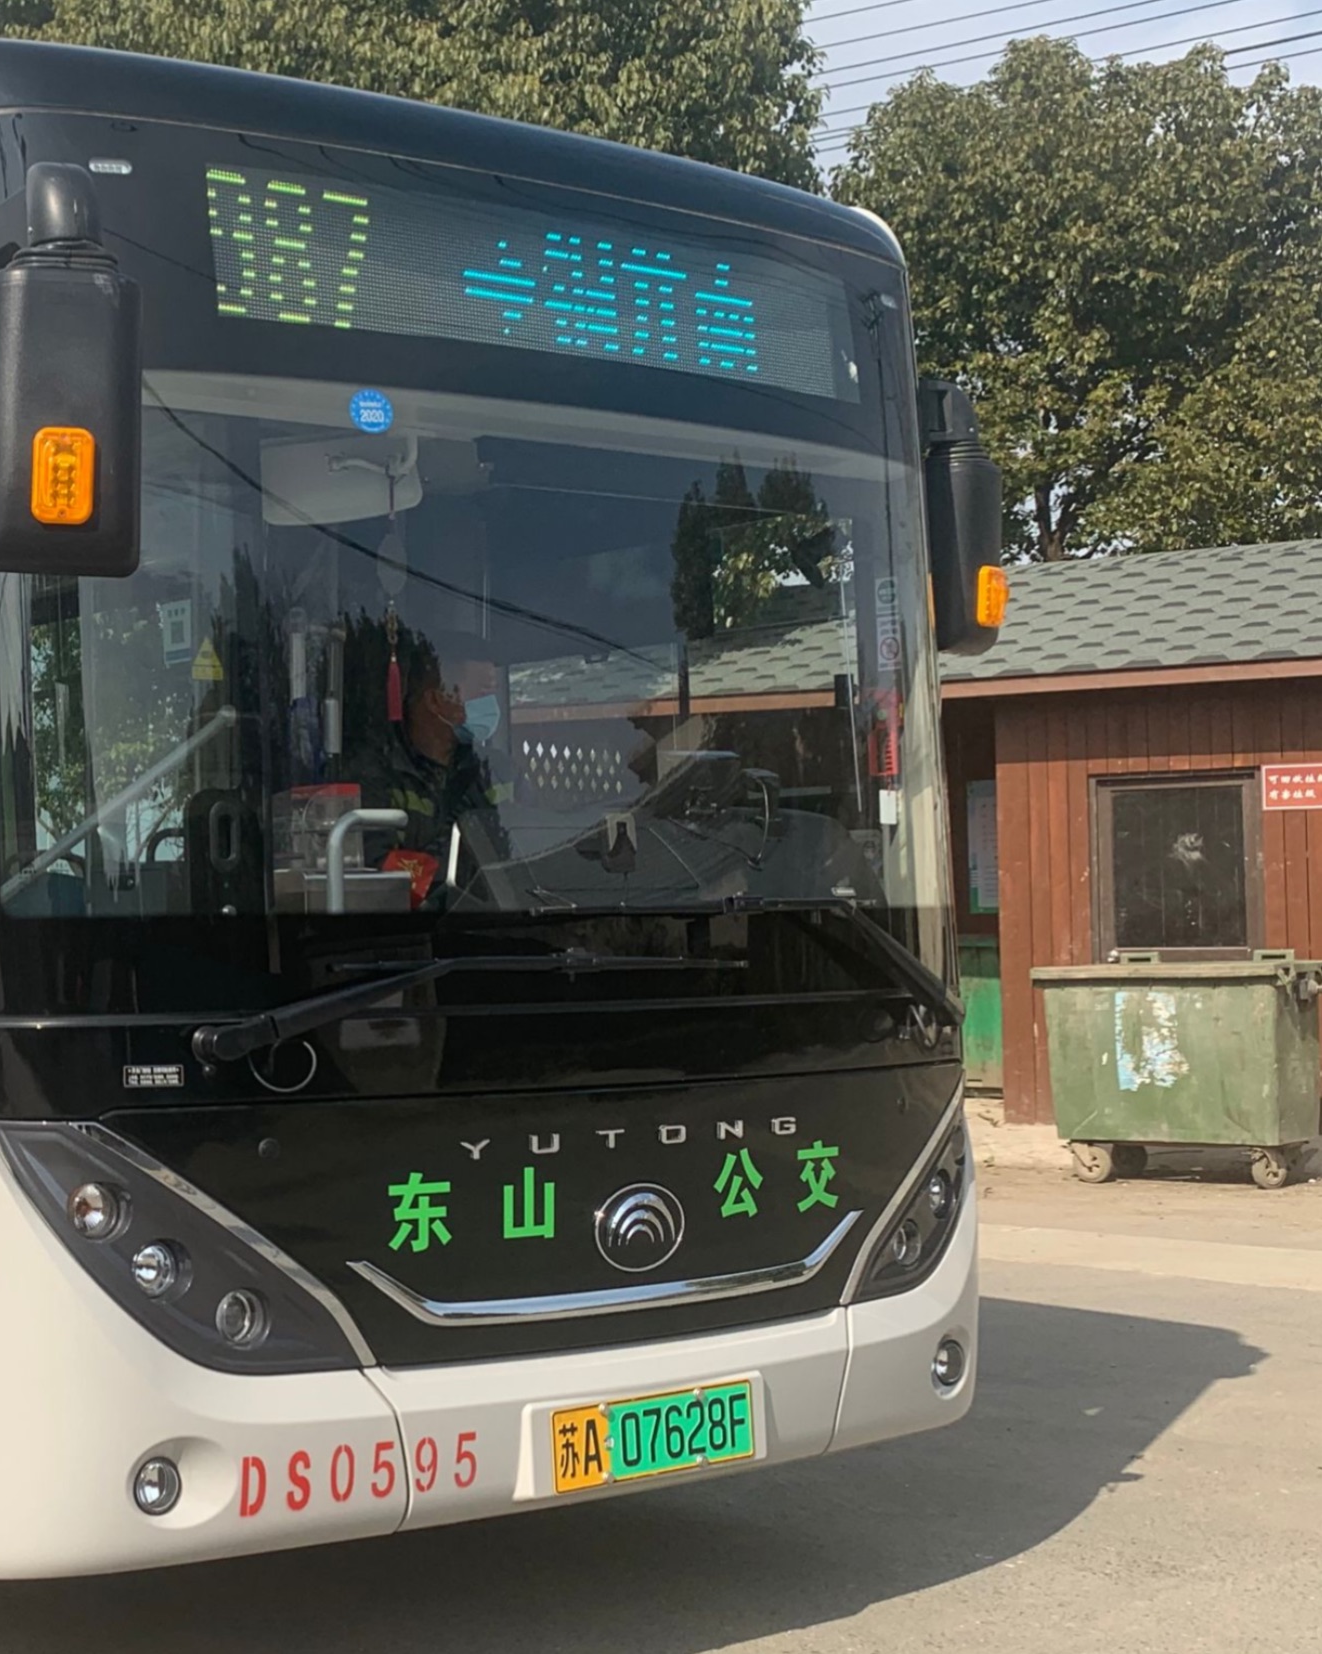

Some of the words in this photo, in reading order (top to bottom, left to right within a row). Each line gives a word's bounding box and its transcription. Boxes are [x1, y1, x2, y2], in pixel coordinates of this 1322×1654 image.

[206, 168, 370, 329] 987
[360, 409, 385, 423] 2020
[459, 1116, 800, 1161] YUTONG
[388, 1165, 557, 1252] 东山
[713, 1139, 841, 1217] 公交
[240, 1430, 480, 1518] DS0595
